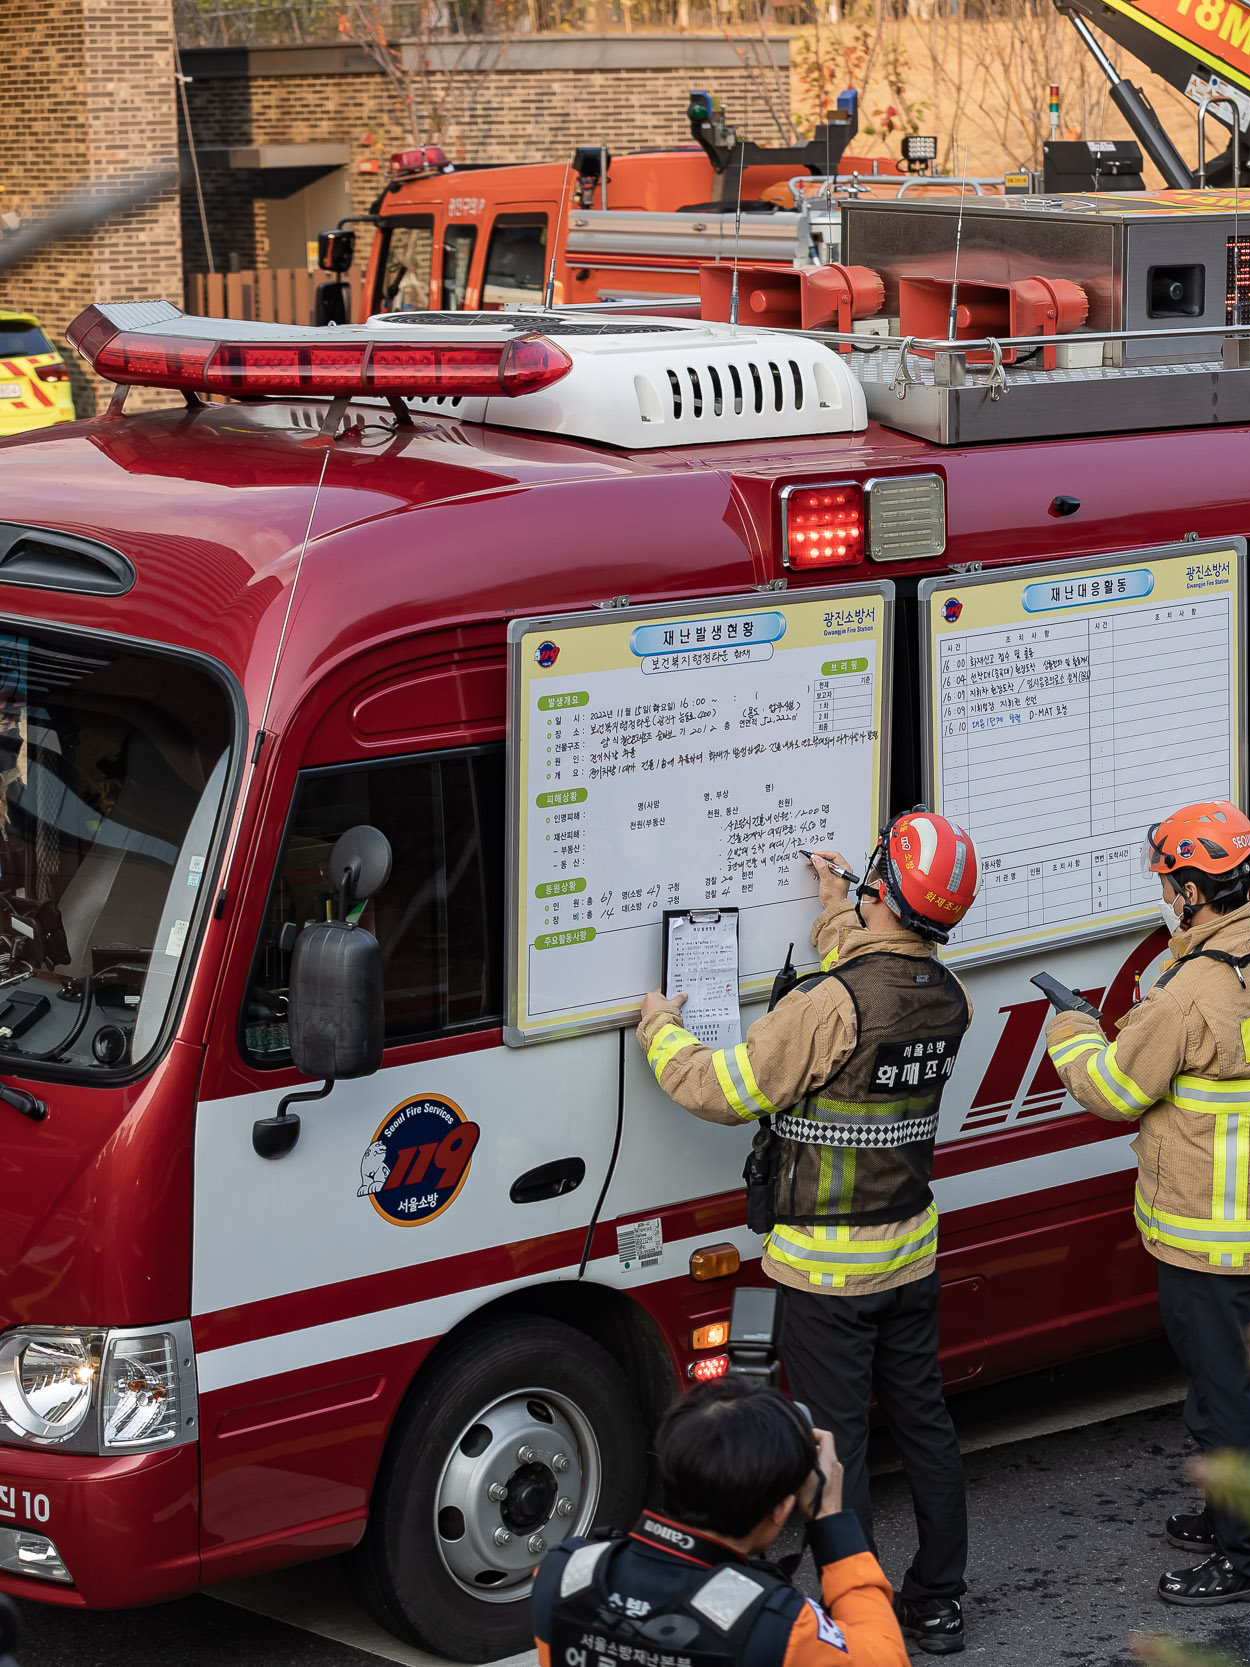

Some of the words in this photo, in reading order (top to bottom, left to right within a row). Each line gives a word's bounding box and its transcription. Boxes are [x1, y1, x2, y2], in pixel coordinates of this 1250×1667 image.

[1185, 561, 1230, 582] 광진소방서
[1050, 577, 1127, 602] 재난대응활동
[1186, 581, 1206, 590] Gwangjin
[1206, 579, 1215, 587] Fire
[1215, 578, 1229, 586] Station
[823, 607, 875, 627] 광진소방서
[663, 622, 754, 645] 재난발생현황
[823, 626, 846, 637] Gwangjin
[847, 625, 857, 634] Fire
[857, 625, 874, 633] Station
[734, 649, 751, 660] 화재
[830, 660, 858, 672] 브리핑
[860, 676, 871, 684] 기준
[547, 695, 579, 708] 발생개요
[816, 691, 833, 699] 보고자
[590, 709, 613, 721] 2022년
[1029, 706, 1054, 720] D-MAT
[554, 741, 581, 753] 건물구조
[545, 791, 578, 804] 피해상황
[553, 811, 580, 824] 인명피해
[715, 789, 729, 800] 부상
[765, 783, 775, 792] 명)
[553, 829, 580, 842] 재산피해
[561, 844, 580, 854] 부동산
[1108, 848, 1129, 861] 도착시간
[904, 853, 916, 870] 소방
[646, 884, 661, 897] 49
[667, 882, 680, 892] 구청
[704, 876, 717, 886] 경찰
[741, 870, 754, 880] 한전
[777, 865, 790, 874] 가스
[995, 871, 1017, 883] 기관명
[545, 881, 577, 895] 동원상황
[667, 895, 680, 905] 구청
[704, 890, 717, 900] 경찰
[741, 884, 754, 893] 한전
[777, 878, 790, 887] 가스
[924, 891, 962, 914] 화재조사
[543, 930, 587, 947] 주요활동사항
[903, 1040, 946, 1059] 서울소방
[876, 1056, 955, 1088] 화재조사
[384, 1112, 406, 1138] Seoul
[405, 1106, 423, 1119] Fire
[424, 1103, 454, 1125] Services
[383, 1121, 479, 1190] 119
[397, 1192, 439, 1213] 서울소방
[22, 1490, 50, 1523] 10
[643, 1519, 695, 1549] Canon
